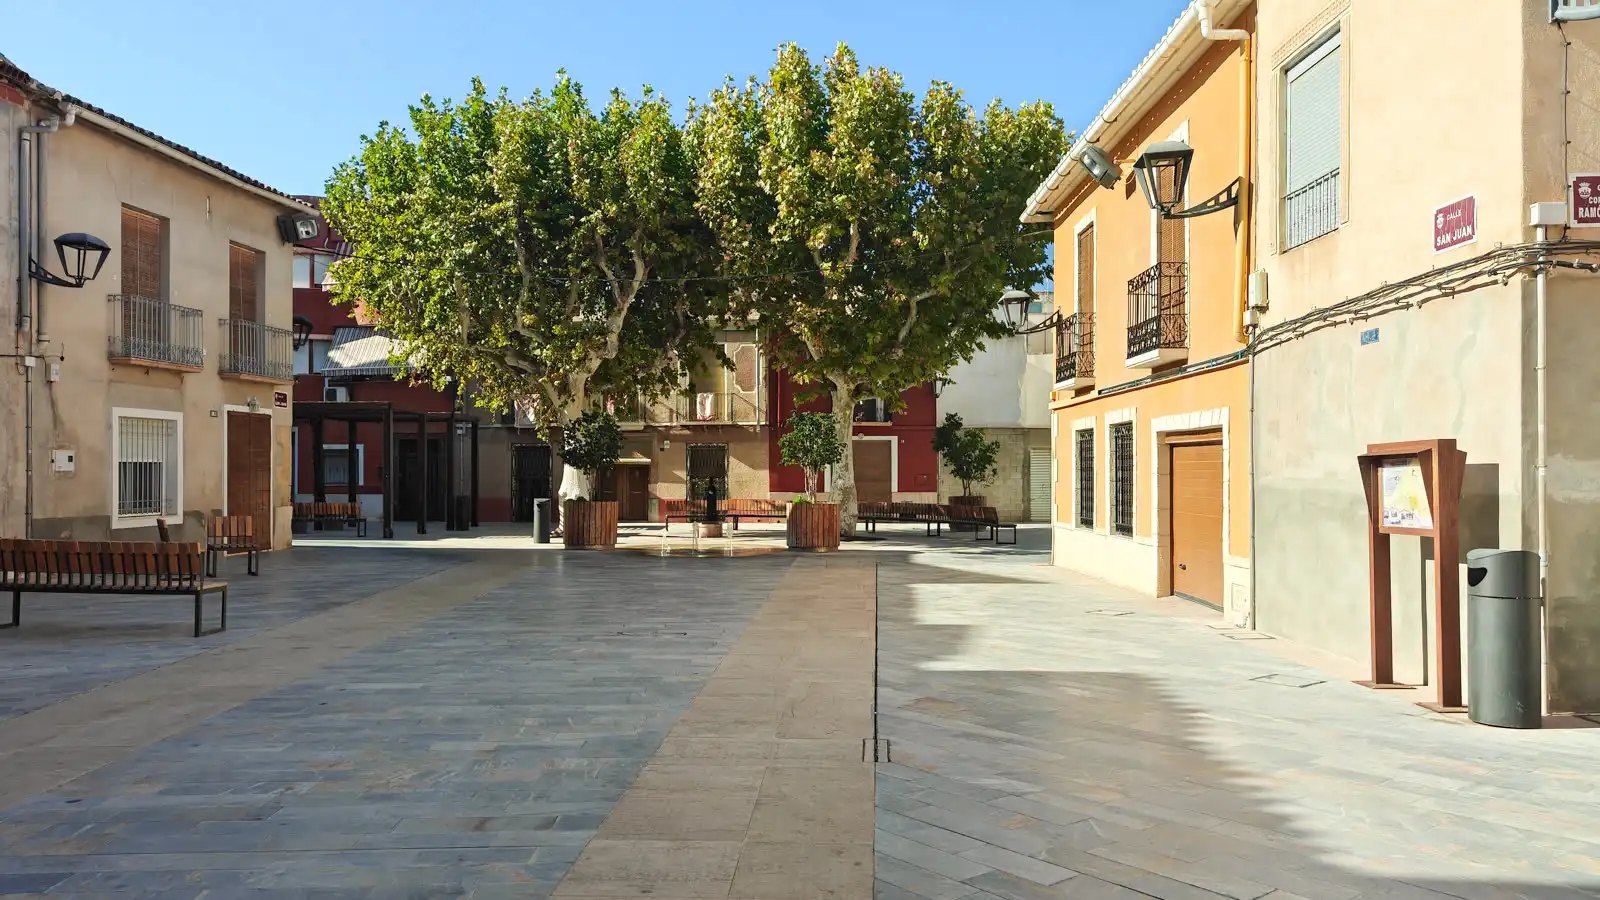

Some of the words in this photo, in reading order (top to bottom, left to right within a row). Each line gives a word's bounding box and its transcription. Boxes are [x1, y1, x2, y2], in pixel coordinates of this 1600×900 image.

[1446, 208, 1462, 221] CALLE
[1436, 232, 1451, 247] SAN
[1453, 224, 1472, 241] JUAN
